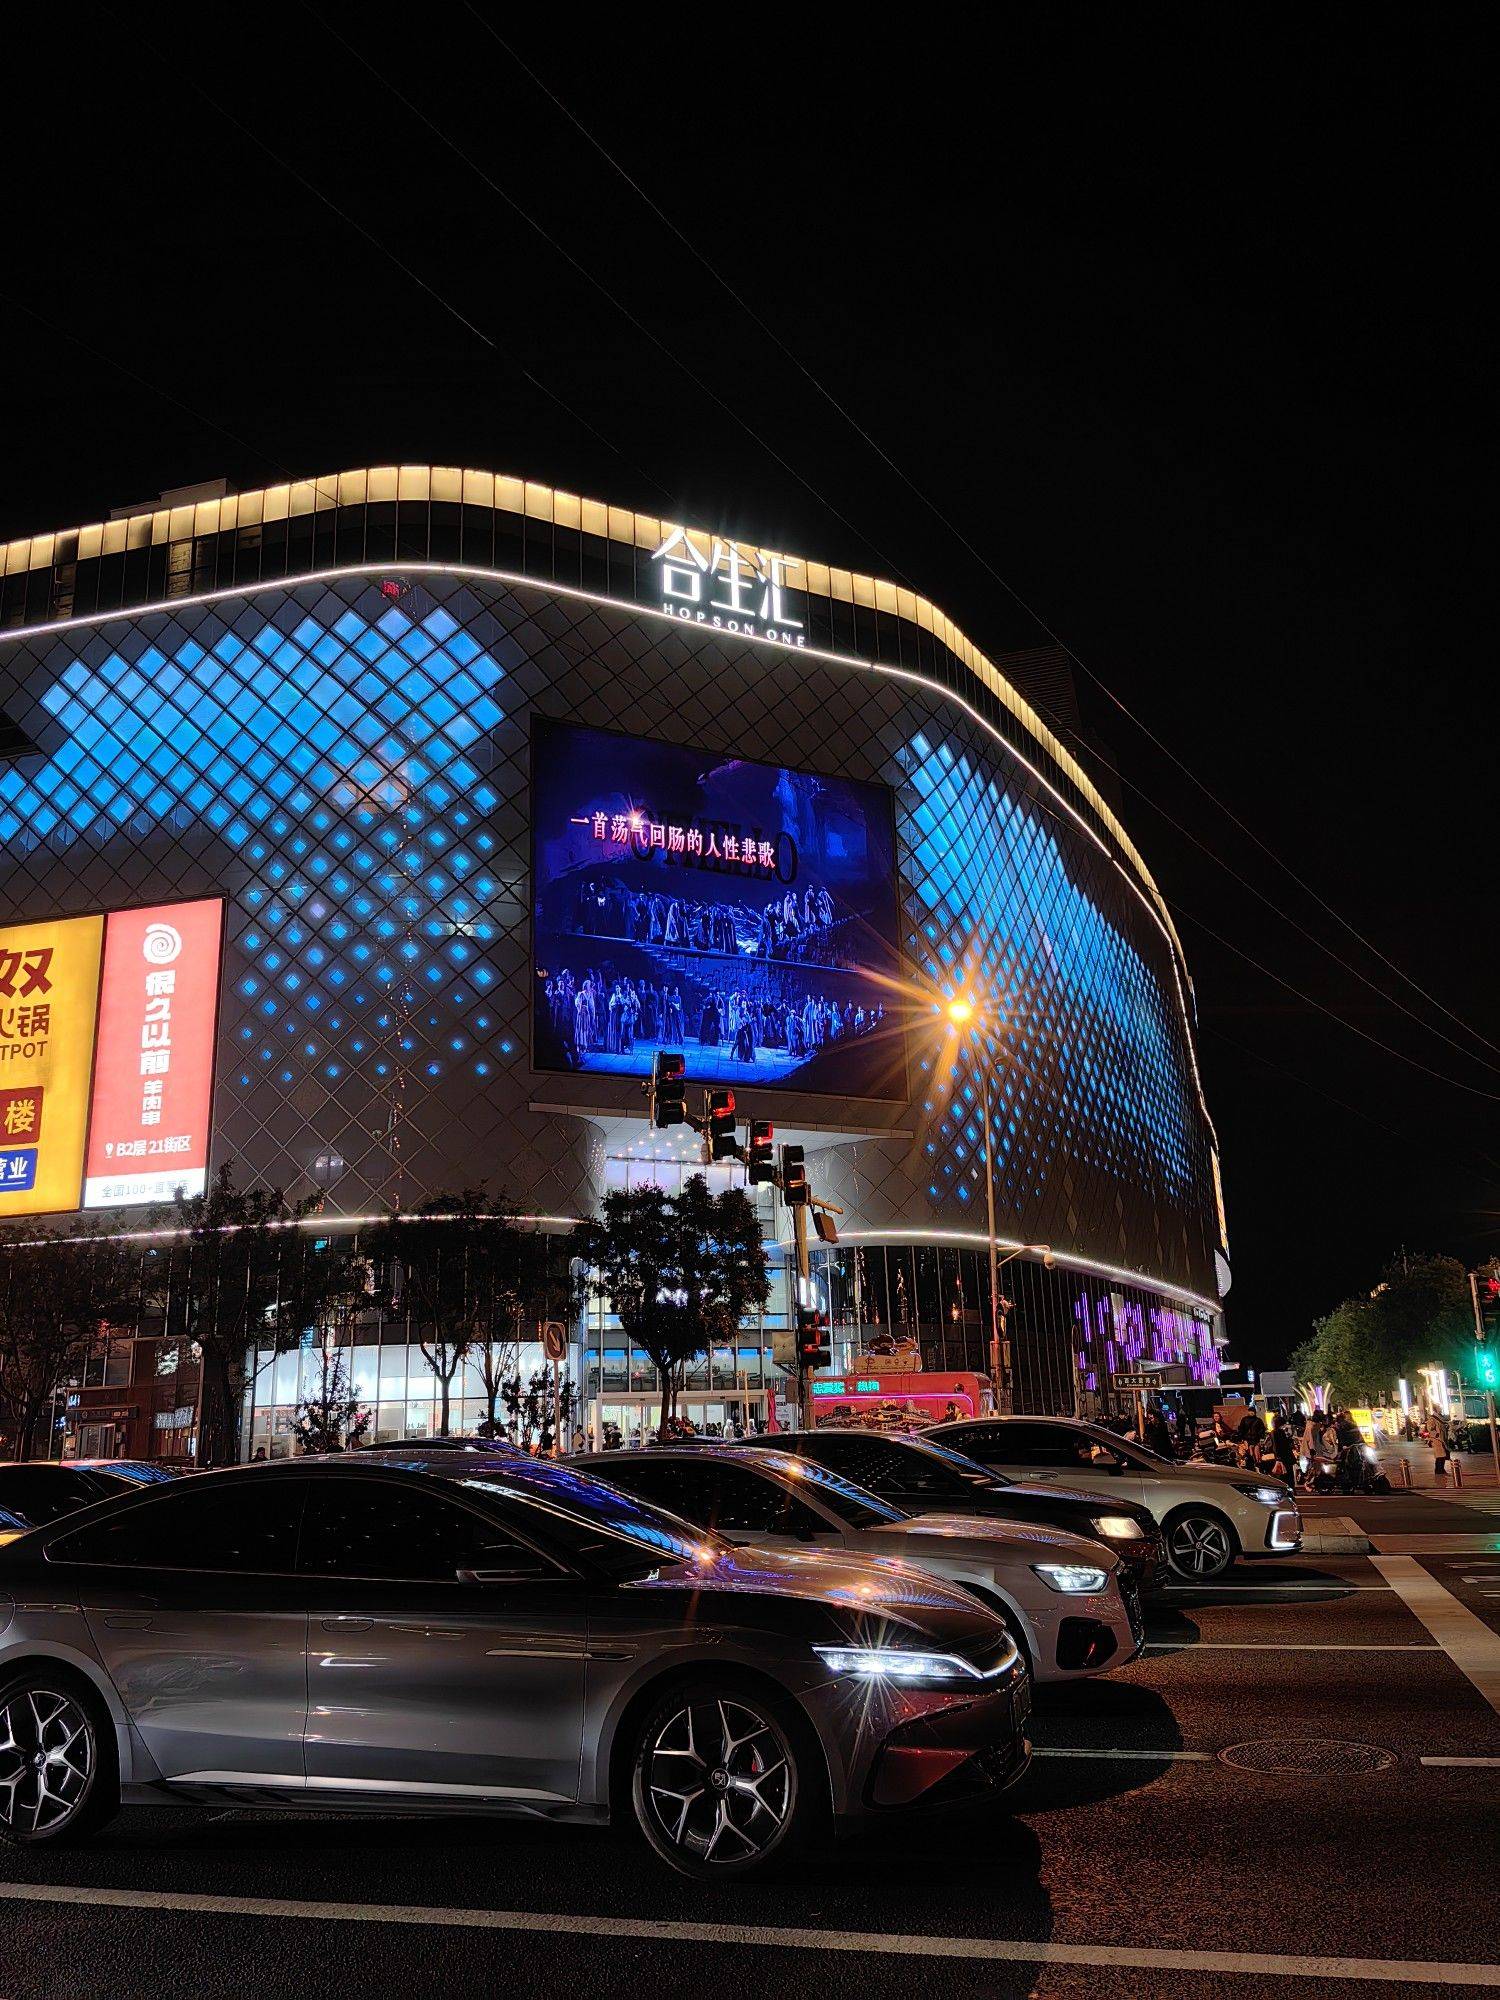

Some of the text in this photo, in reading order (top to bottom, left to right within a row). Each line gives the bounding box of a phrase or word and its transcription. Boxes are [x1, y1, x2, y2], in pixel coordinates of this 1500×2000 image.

[651, 527, 804, 628] 合生汇
[663, 602, 806, 648] HOPSON ONE
[570, 811, 776, 869] 一首荡气回肠的人性悲歌
[140, 969, 176, 1075] 很久以前
[4, 1099, 35, 1134] 楼
[116, 1135, 193, 1157] B2层 21街区
